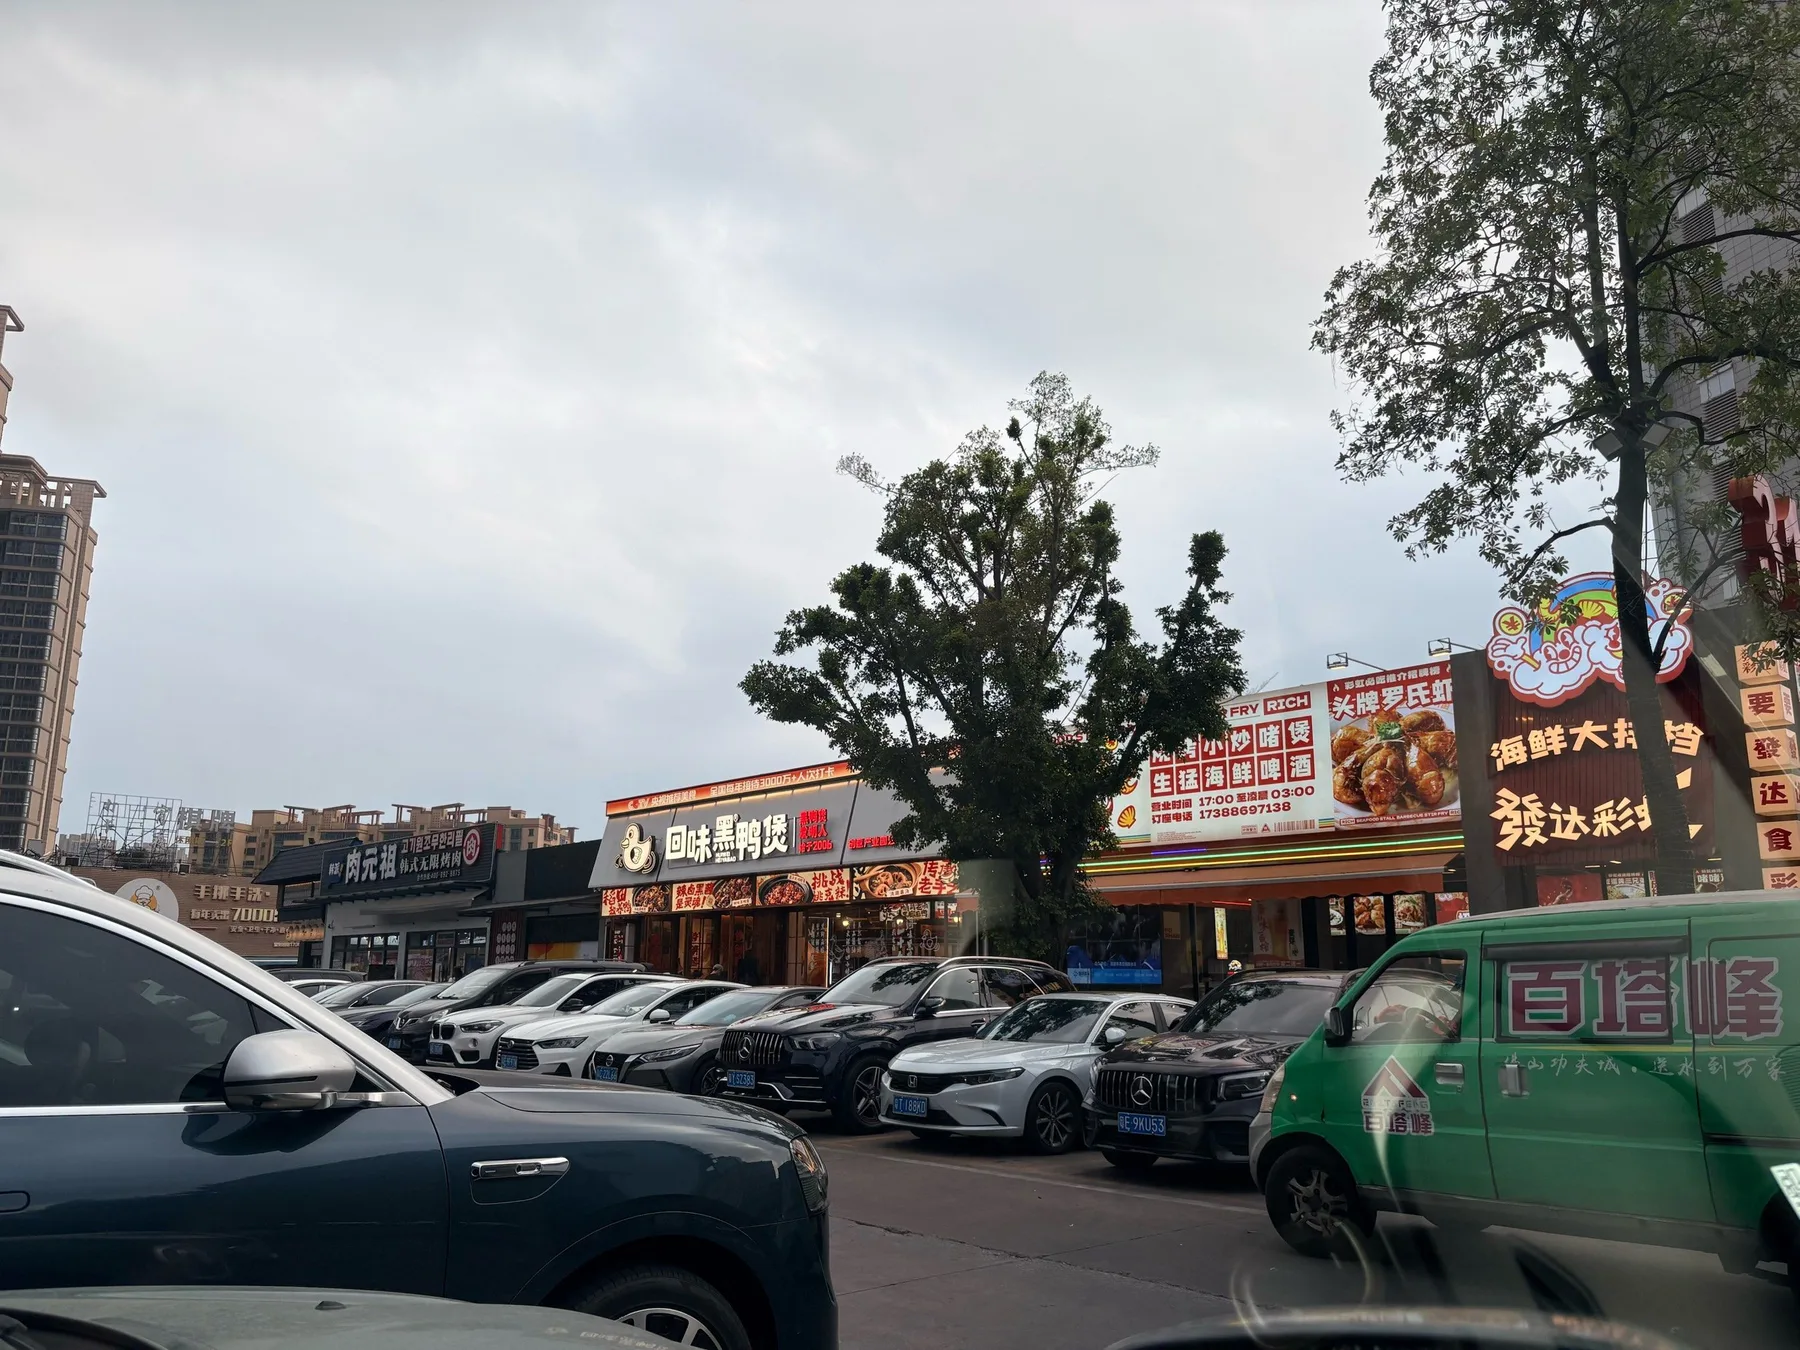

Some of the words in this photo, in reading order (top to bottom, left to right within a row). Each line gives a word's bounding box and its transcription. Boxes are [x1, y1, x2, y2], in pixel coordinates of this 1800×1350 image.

[1229, 703, 1259, 717] FRY
[1266, 695, 1309, 711] RICH
[1152, 753, 1312, 795] 生猛海鲜啤酒
[1151, 798, 1192, 812] 营业时间
[1199, 795, 1234, 807] 17:00
[1236, 790, 1268, 803] 至凌晨
[1271, 785, 1315, 799] 03:00
[799, 808, 828, 825] 黑鸭煲
[1151, 811, 1193, 825] 订座电话
[1199, 802, 1292, 820] 17388697138
[400, 830, 464, 854] 고기원조무한리필
[665, 813, 789, 863] 回味黑鸭煲
[799, 823, 828, 839] 发明人
[798, 839, 833, 853] 始于2006
[344, 843, 398, 885] 肉元祖
[400, 850, 462, 874] 韩式无限烤肉
[1508, 958, 1783, 1039] 百塔峰
[1363, 1111, 1432, 1134] 百塔峰
